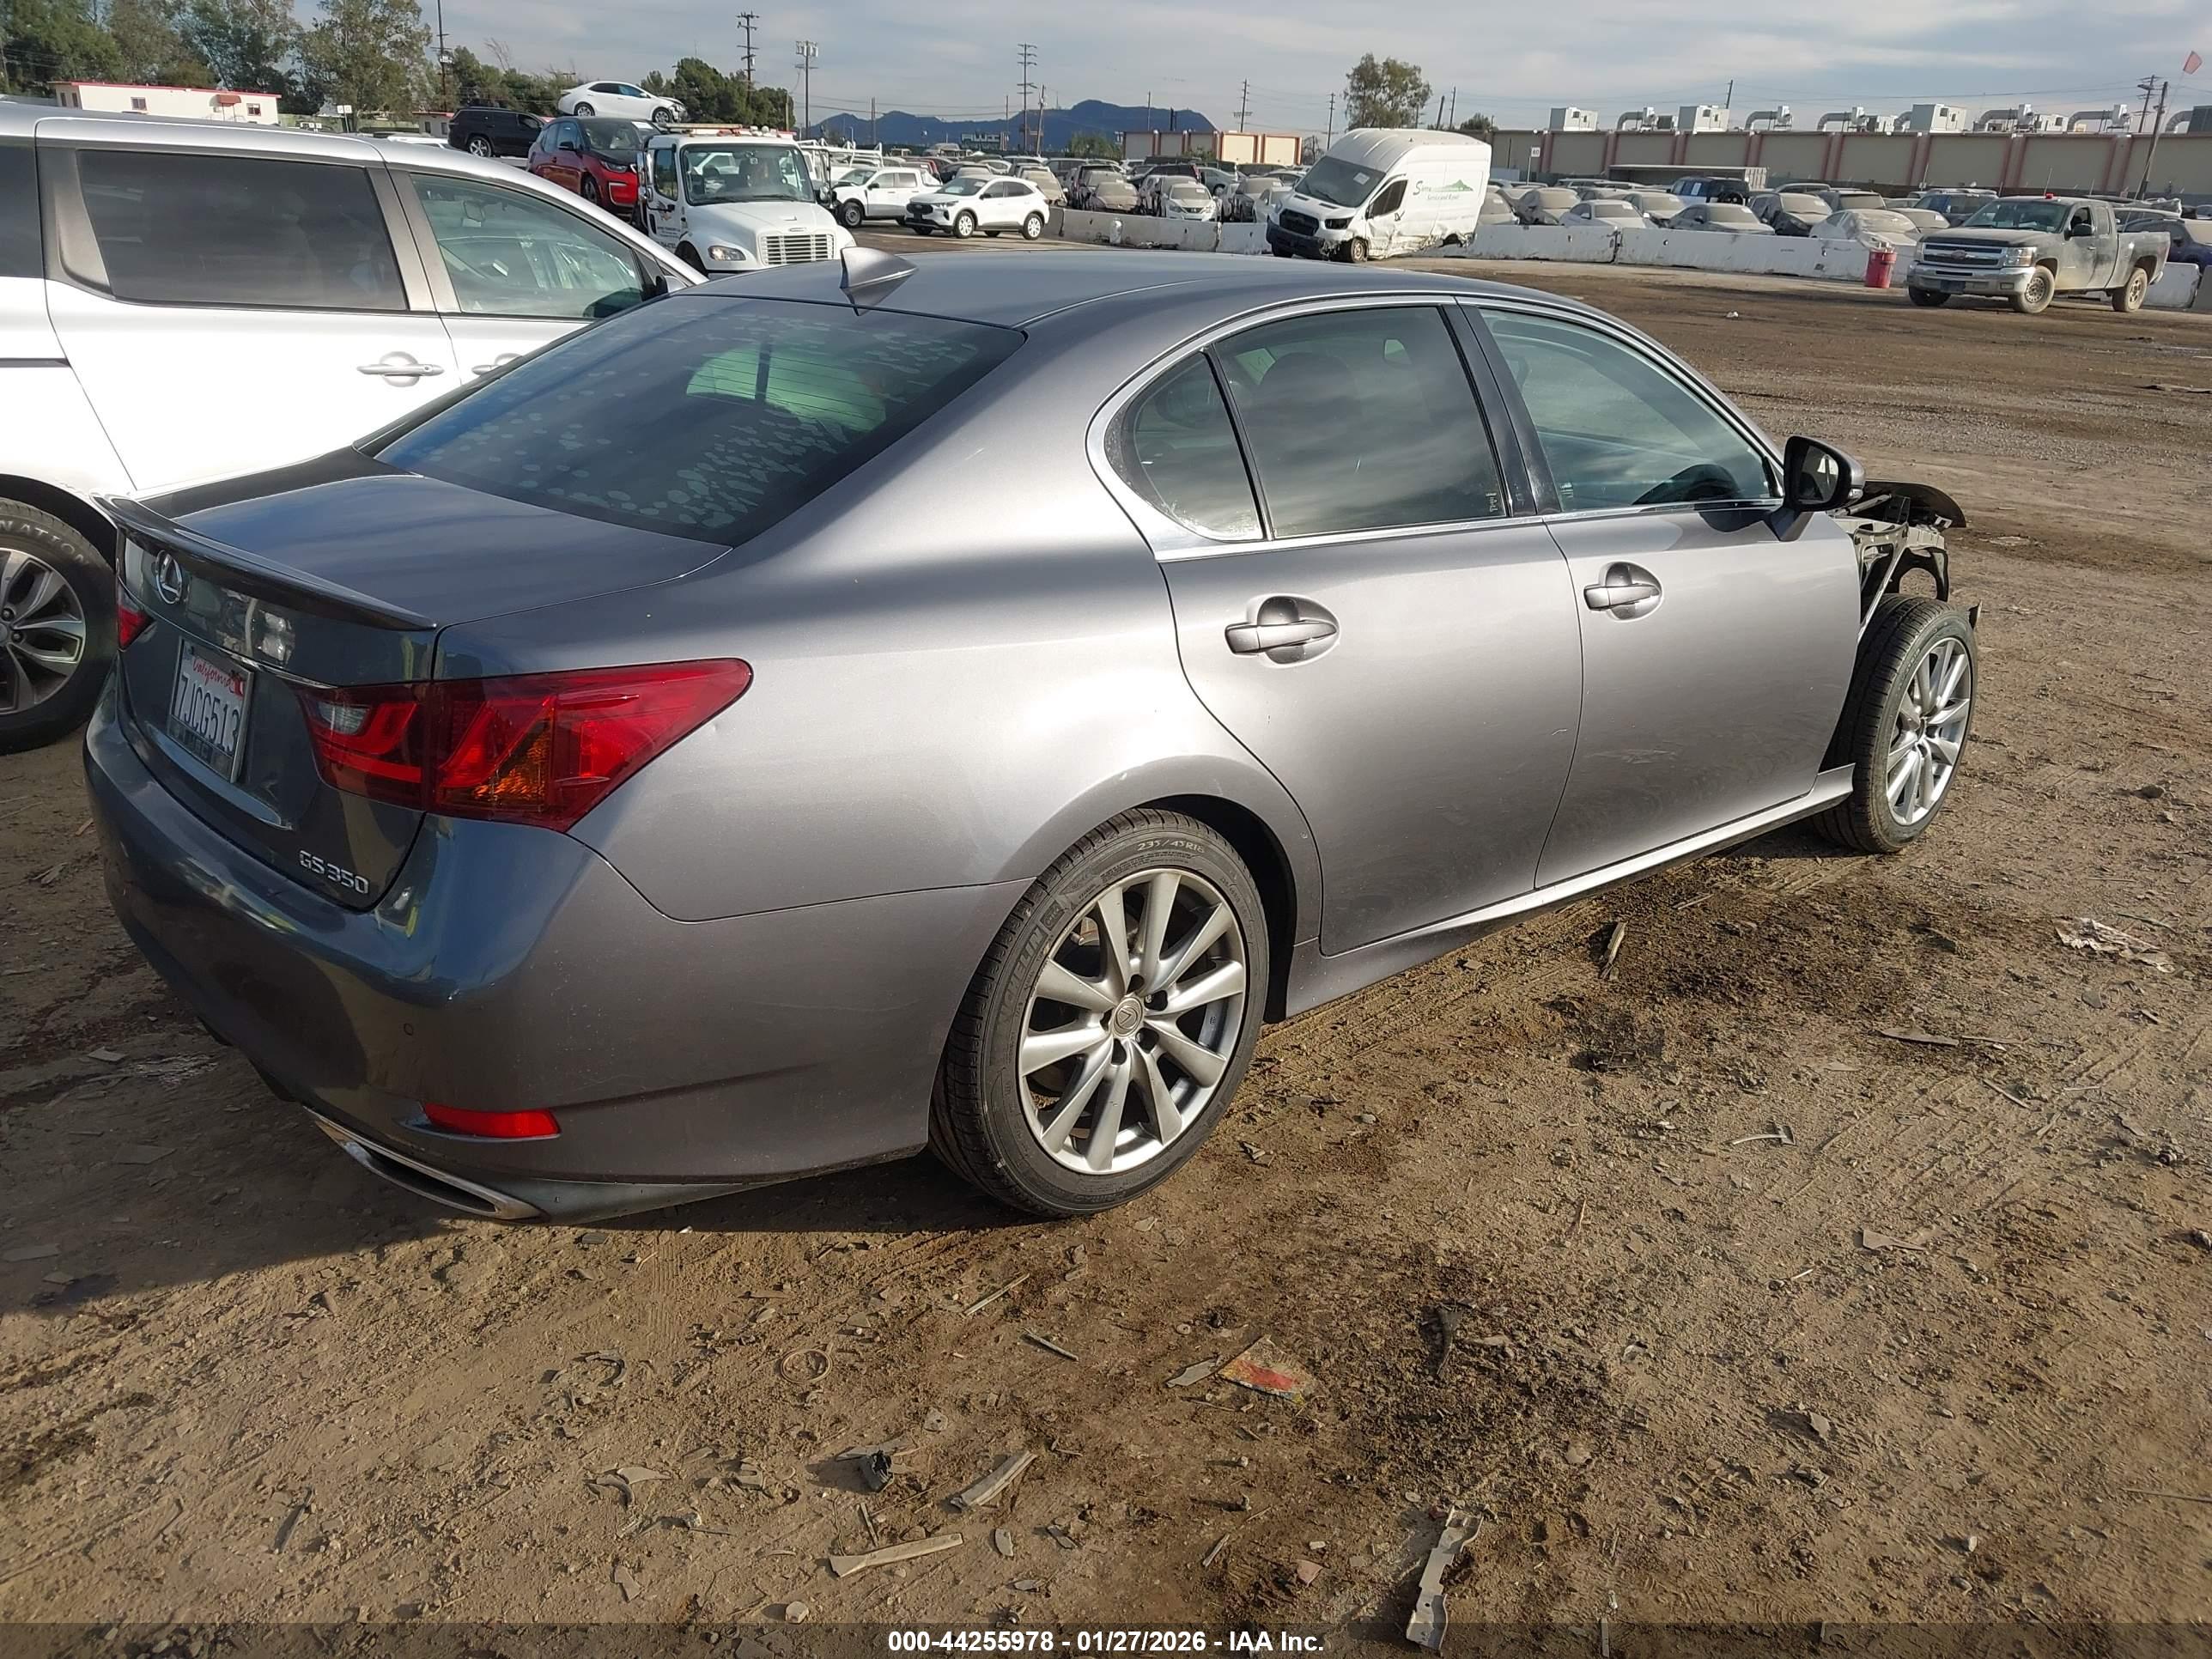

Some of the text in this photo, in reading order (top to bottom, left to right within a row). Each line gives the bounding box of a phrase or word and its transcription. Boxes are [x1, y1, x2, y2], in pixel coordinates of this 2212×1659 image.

[178, 674, 241, 756] 7JCG513
[300, 850, 369, 894] GS 350
